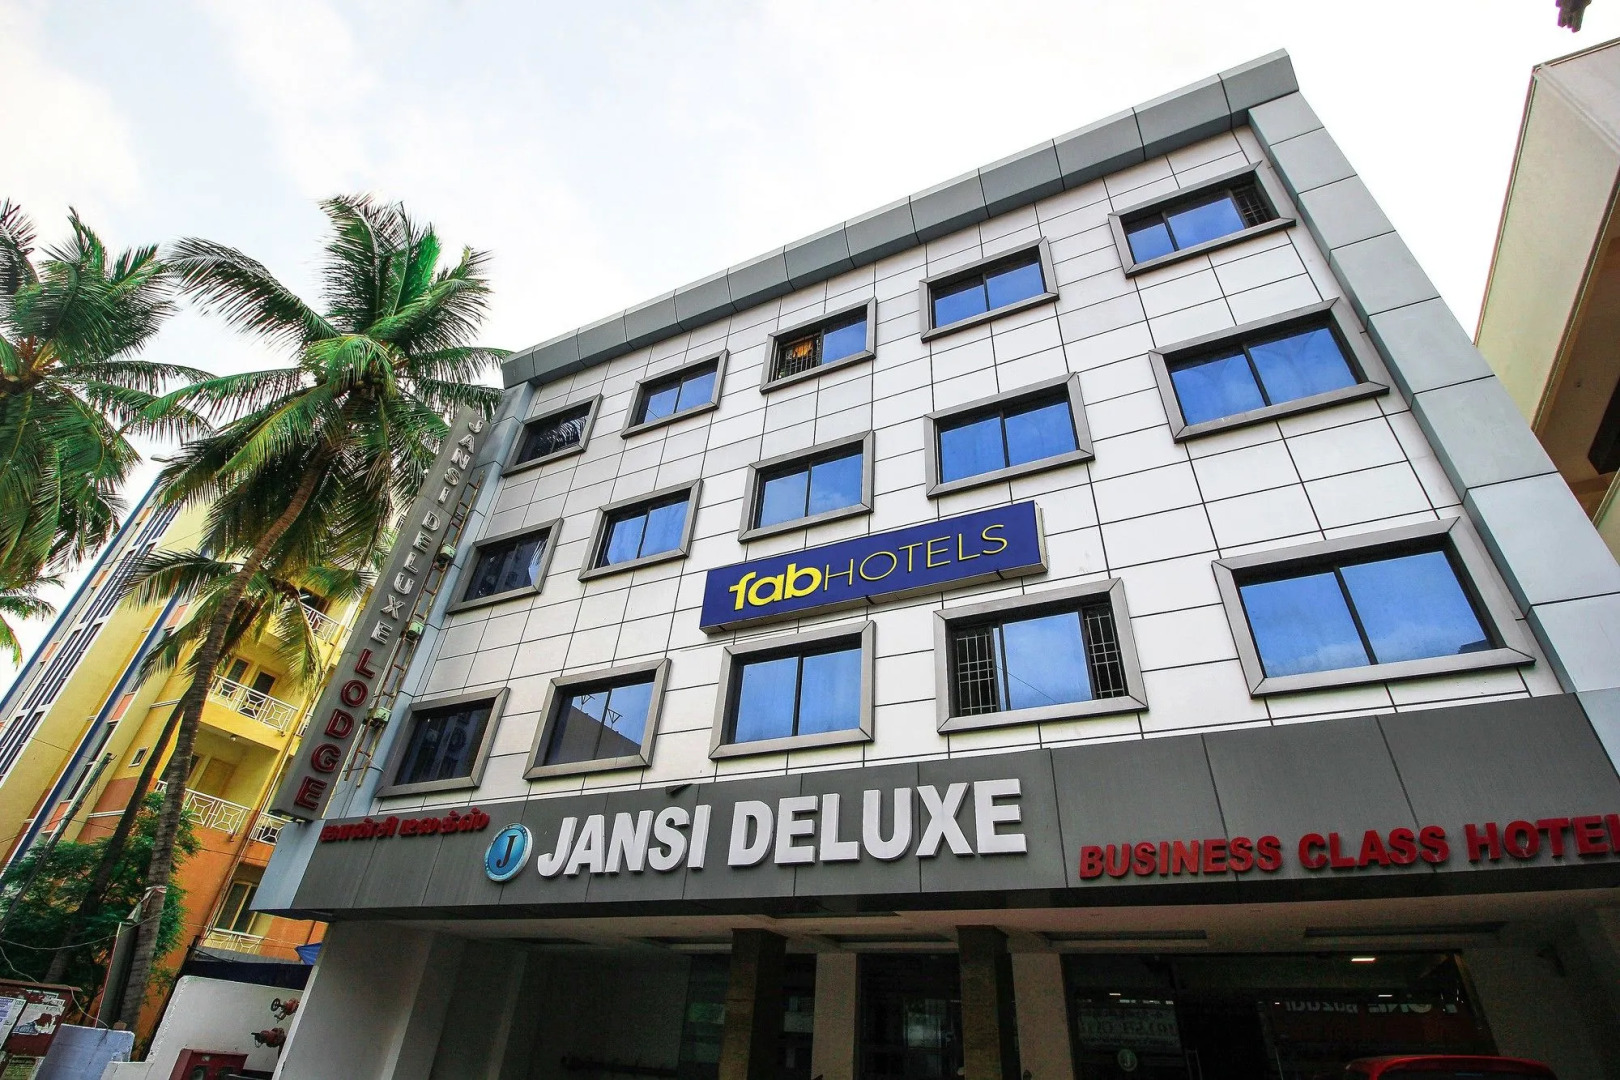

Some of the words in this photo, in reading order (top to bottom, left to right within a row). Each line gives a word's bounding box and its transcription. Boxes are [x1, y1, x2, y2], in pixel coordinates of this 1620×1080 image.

[438, 420, 484, 504] JANSI
[370, 510, 441, 645] DELUXE
[294, 648, 376, 811] LODGE
[496, 835, 518, 868] J
[537, 804, 712, 877] JANSI
[727, 778, 1027, 867] DELUXE
[1079, 835, 1284, 880] BUSINESS
[1298, 825, 1450, 869] CLASS
